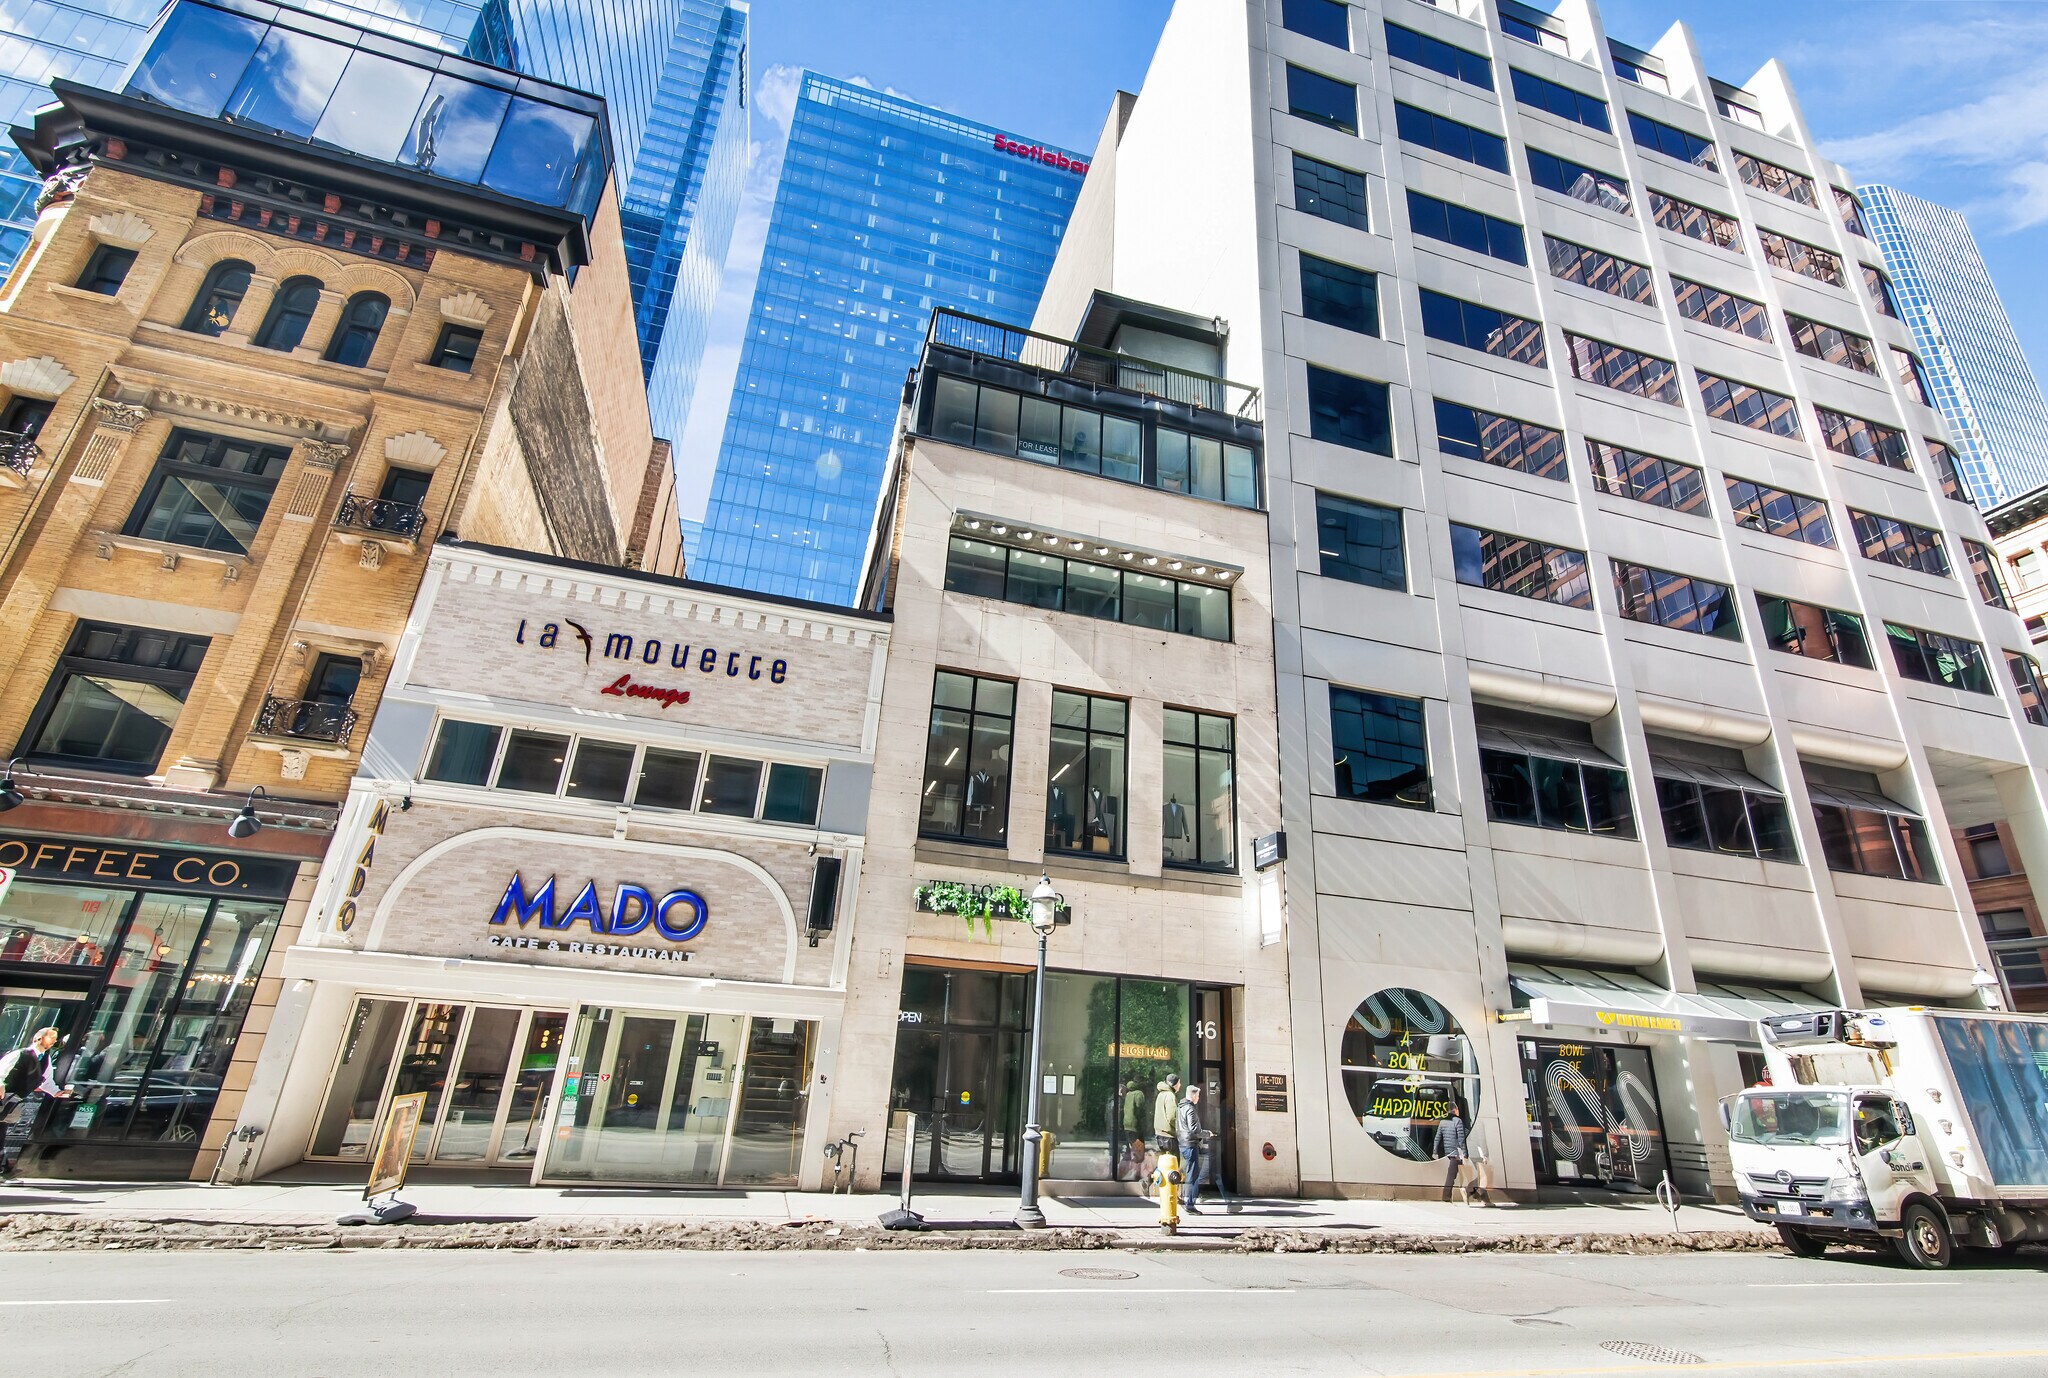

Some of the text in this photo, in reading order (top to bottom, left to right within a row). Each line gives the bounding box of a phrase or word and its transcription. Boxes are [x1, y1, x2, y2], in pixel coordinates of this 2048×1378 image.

[1018, 440, 1058, 455] FOR LEASE
[603, 632, 788, 684] mouette
[600, 674, 692, 709] Lounge
[172, 857, 249, 890] CO.
[336, 798, 392, 932] MADO
[489, 869, 708, 942] MADO
[487, 935, 697, 962] CAFE & RESTAURANT
[1109, 1045, 1125, 1055] TE
[1400, 1031, 1410, 1047] A
[1559, 1043, 1585, 1057] BOWL
[1388, 1052, 1426, 1071] BOWL
[1373, 1097, 1450, 1119] HAPPINESS
[1890, 1162, 1913, 1172] Bondi
